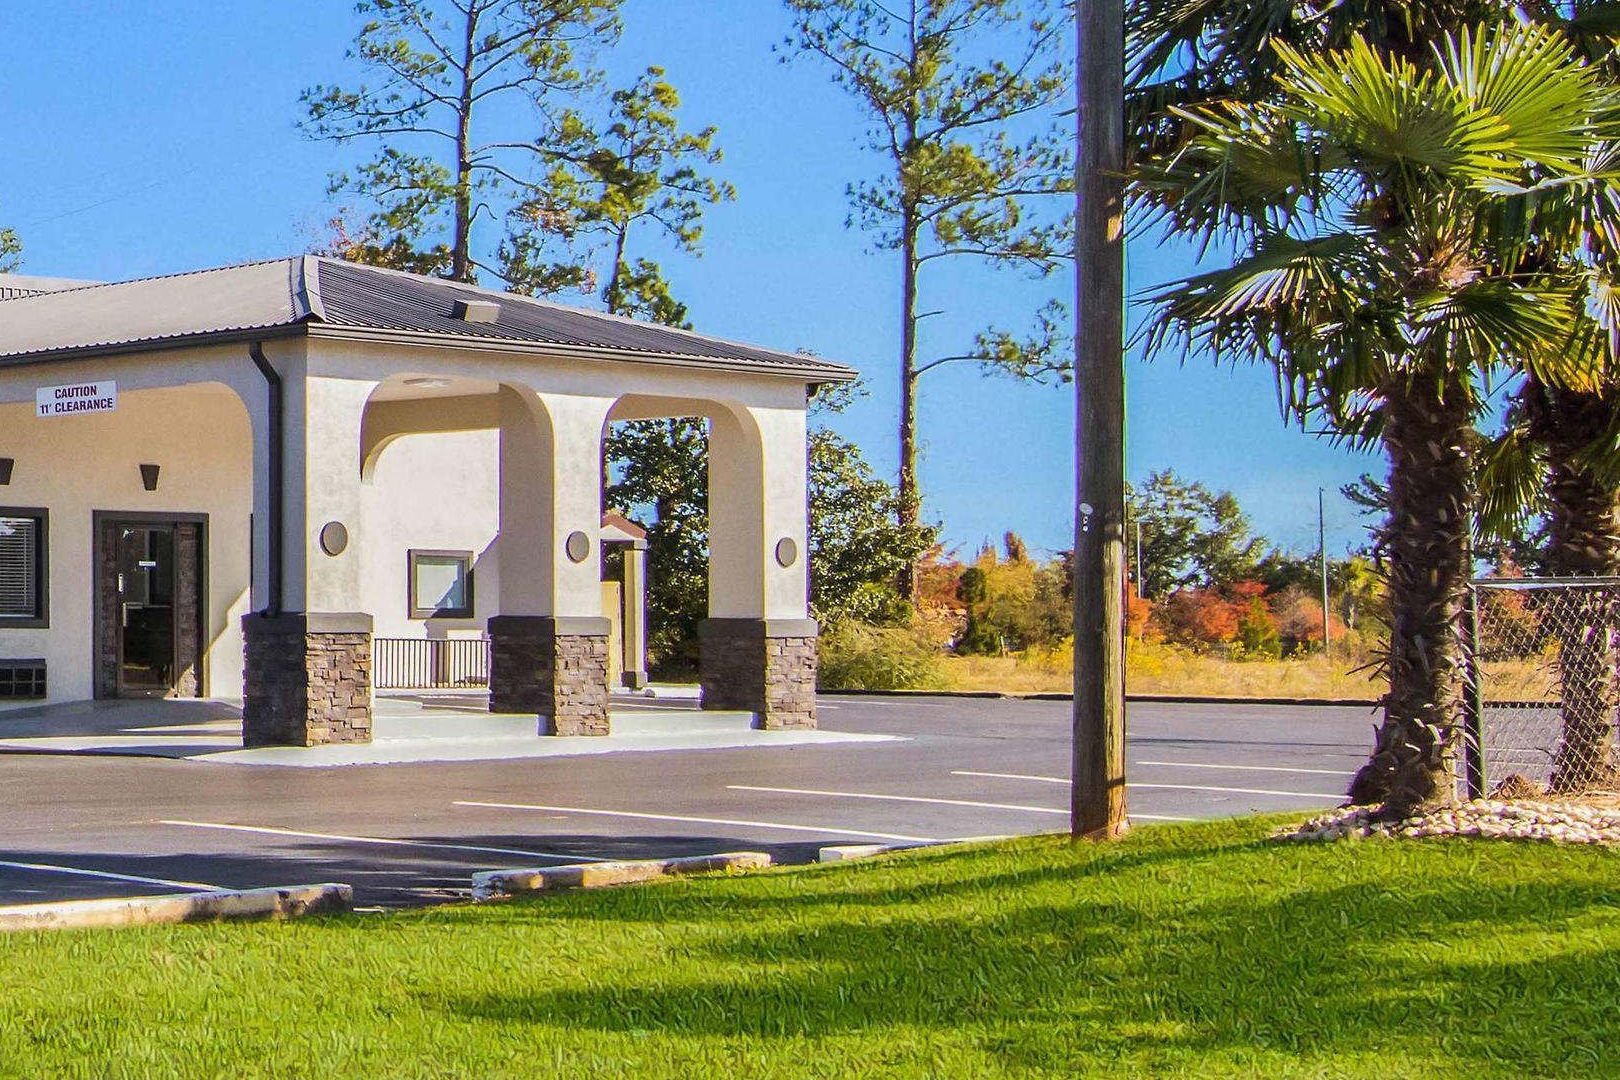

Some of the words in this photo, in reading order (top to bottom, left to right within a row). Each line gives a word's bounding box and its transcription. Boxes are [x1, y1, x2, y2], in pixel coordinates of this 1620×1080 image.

[55, 385, 97, 399] CAUTION
[40, 404, 52, 414] 11'
[55, 398, 113, 413] CLEARANCE
